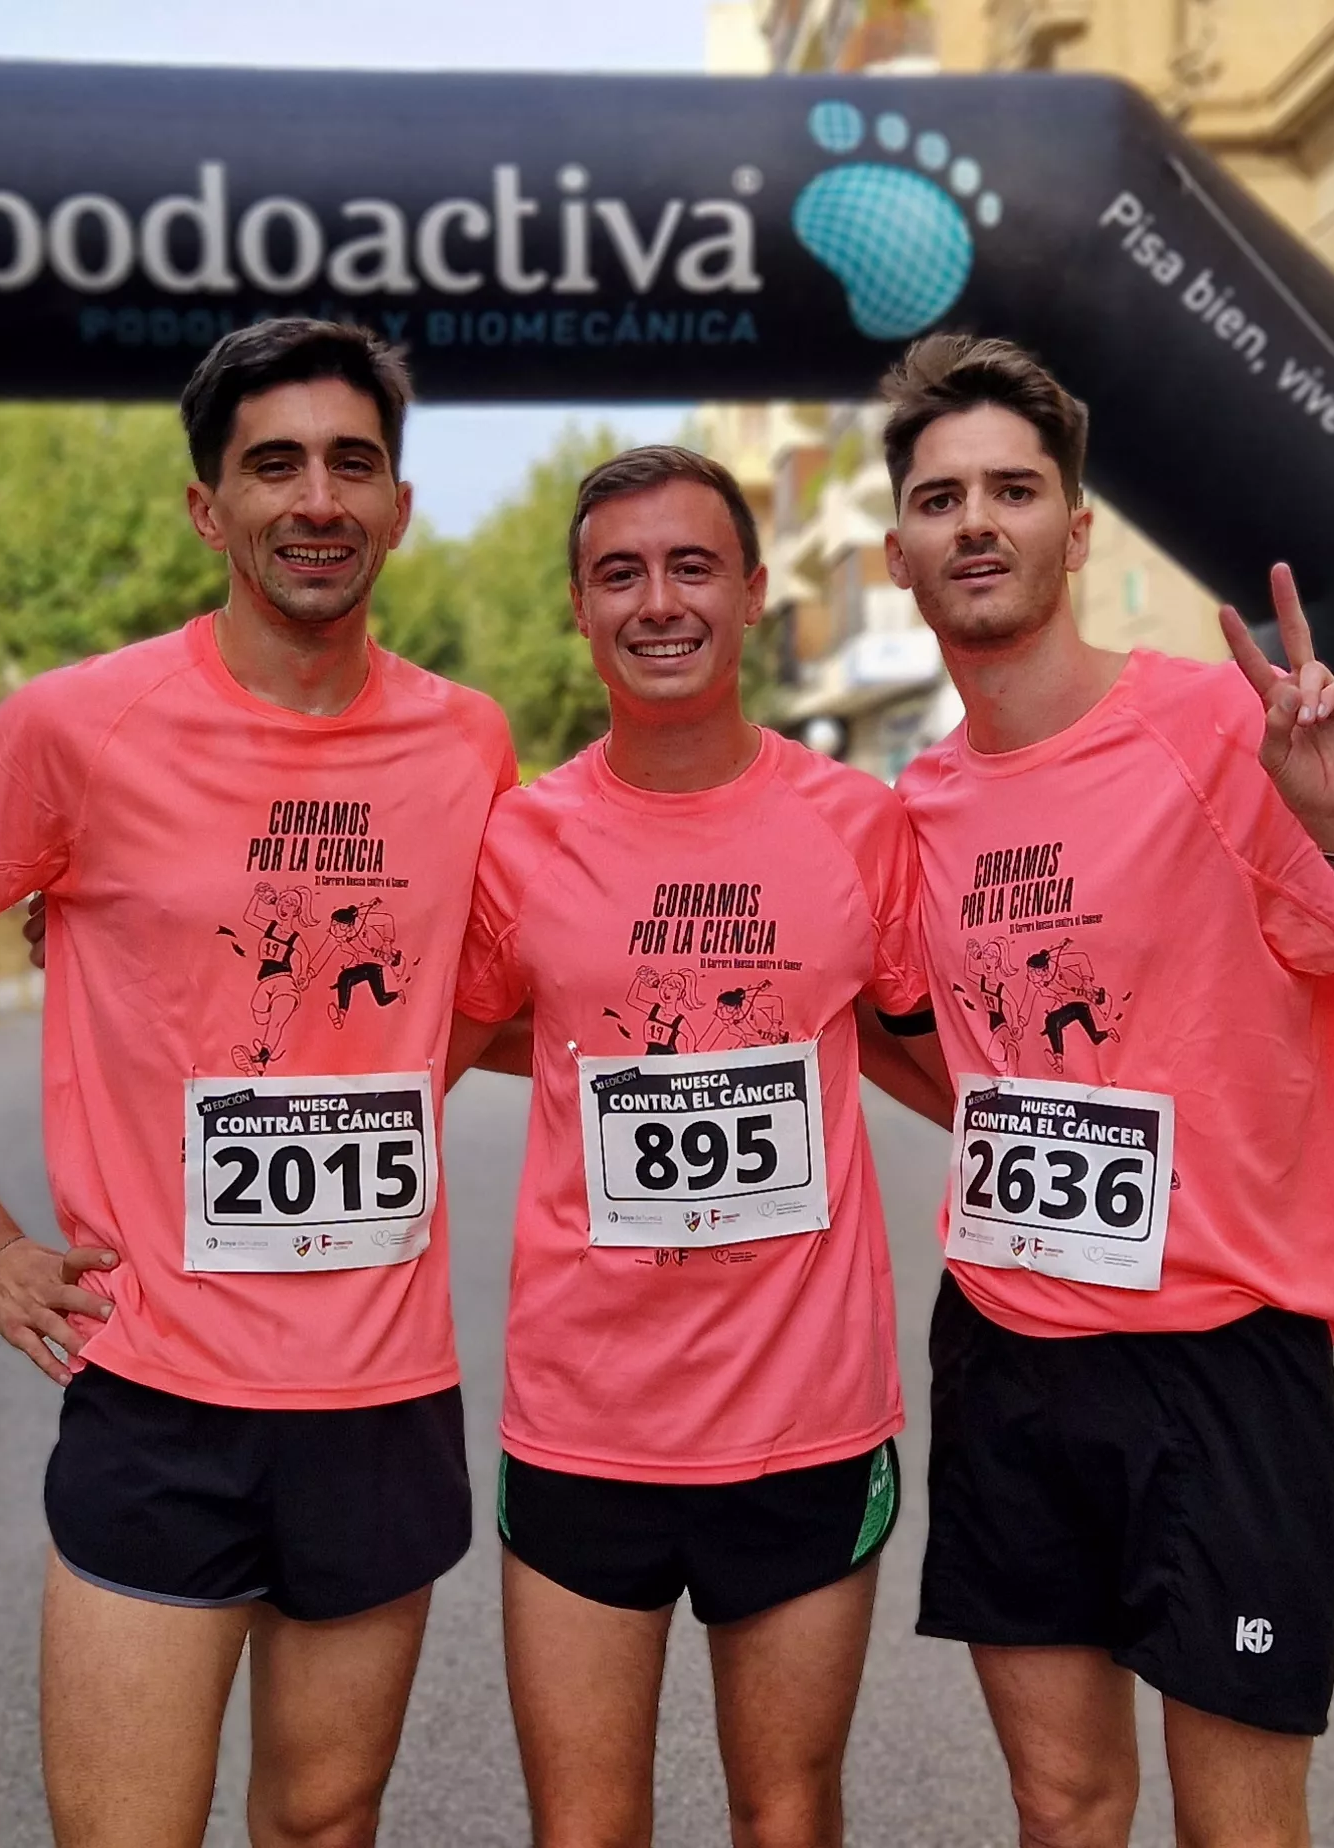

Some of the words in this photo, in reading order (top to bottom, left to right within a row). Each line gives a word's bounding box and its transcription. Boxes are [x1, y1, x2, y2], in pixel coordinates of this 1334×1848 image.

[1098, 190, 1185, 287] Pisa
[1181, 268, 1268, 374] bien,
[426, 302, 759, 345] BIOMECÁNICA
[269, 800, 371, 836] CORRAMOS
[246, 838, 284, 872] POR
[289, 837, 310, 871] LA
[315, 838, 384, 872] CIENCIA
[974, 842, 1063, 889] CORRAMOS
[653, 883, 761, 917] CORRAMOS
[960, 891, 985, 930] POR
[988, 887, 1005, 924] LA
[1009, 877, 1074, 920] CIENCIA
[266, 941, 280, 958] 19
[628, 920, 668, 955] POR
[672, 920, 694, 954] LA
[700, 920, 776, 954] CIENCIA
[649, 1024, 664, 1041] 19
[595, 1081, 604, 1091] XI
[605, 1070, 636, 1088] EDICIÓN
[609, 1093, 688, 1111] CONTRA
[693, 1091, 715, 1108] EL
[719, 1082, 796, 1105] CÁNCER
[671, 1073, 730, 1091] HUESCA
[202, 1102, 212, 1113] XI
[212, 1092, 250, 1111] EDICIÓN
[289, 1098, 349, 1112] HUESCA
[1021, 1100, 1076, 1118] HUESCA
[216, 1116, 304, 1134] CONTRA
[309, 1114, 331, 1132] EL
[337, 1109, 414, 1130] CÁNCER
[970, 1110, 1032, 1133] CONTRA
[1036, 1119, 1057, 1136] EL
[1062, 1119, 1146, 1146] CÁNCER
[634, 1113, 778, 1191] 895
[212, 1140, 418, 1215] 2015
[965, 1139, 1144, 1228] 2636
